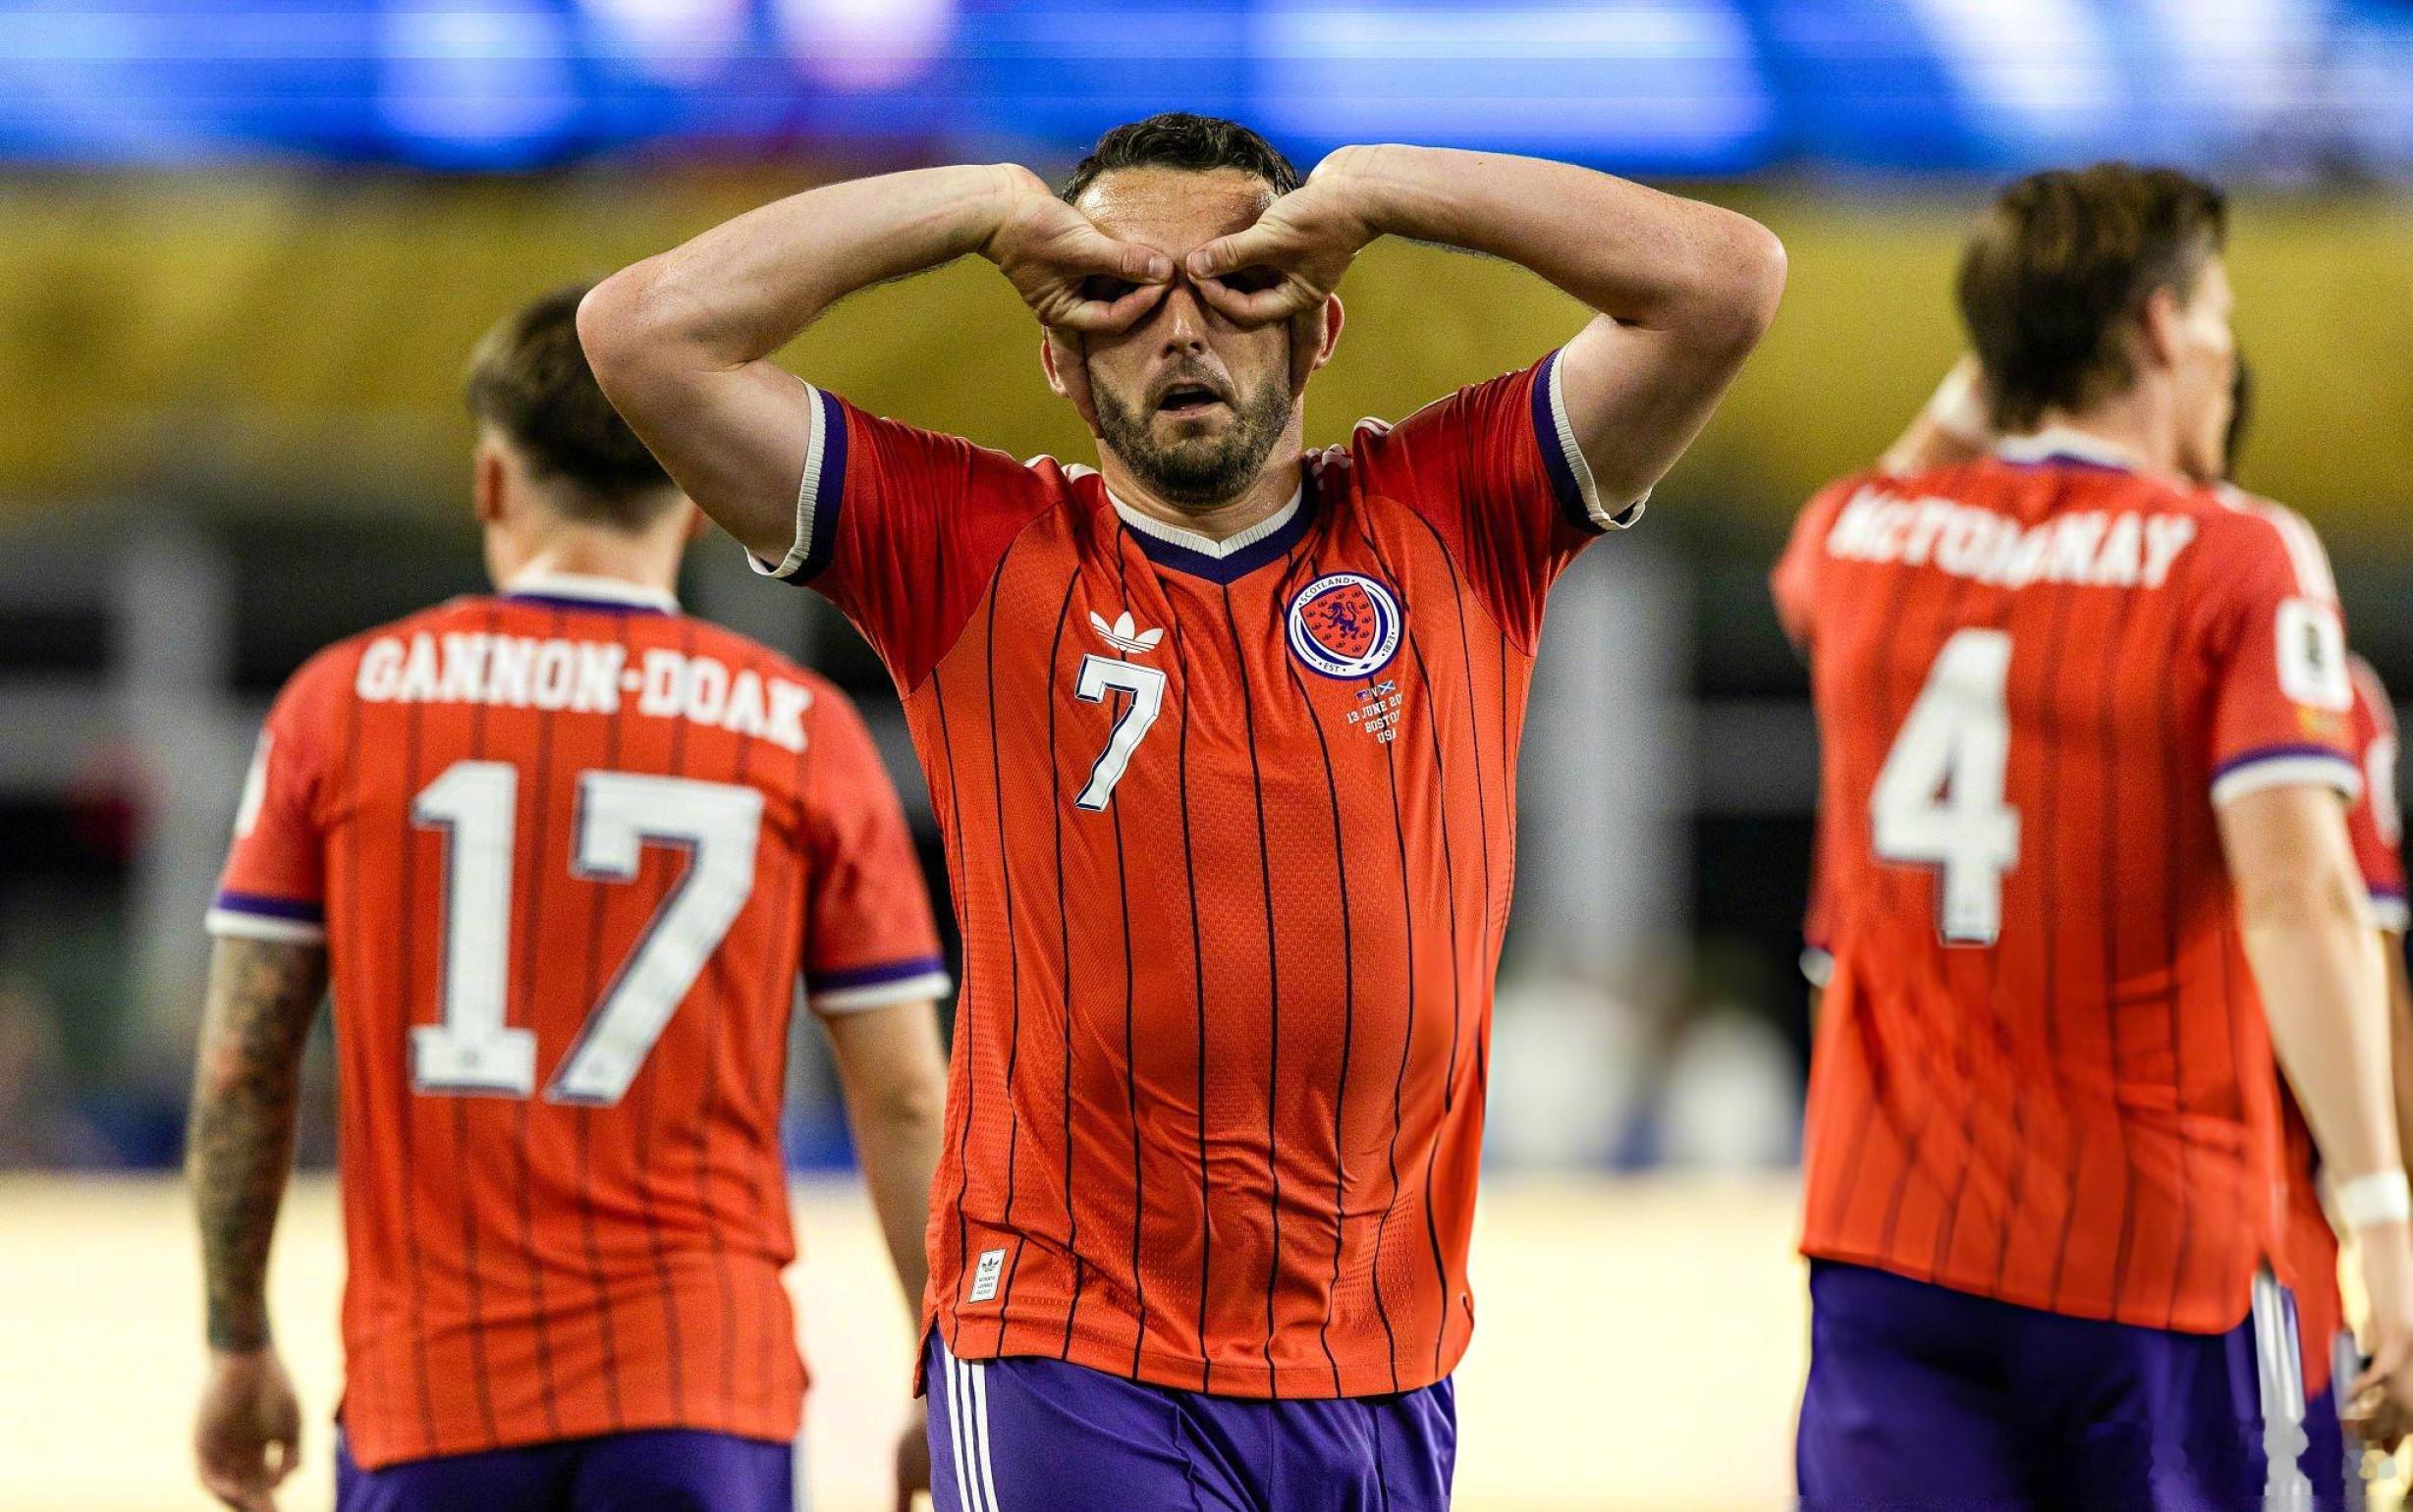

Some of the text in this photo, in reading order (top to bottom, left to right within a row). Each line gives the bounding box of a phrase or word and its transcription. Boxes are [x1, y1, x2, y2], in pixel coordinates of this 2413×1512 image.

[1300, 577, 1350, 603] SCOTLAND
[1323, 662, 1341, 673] EST
[1382, 635, 1396, 654] 1873
[355, 631, 814, 753] GANNON-DOAK
[1346, 711, 1359, 724] 13
[1361, 700, 1388, 719] JUNE
[1074, 653, 1167, 813] 7
[1871, 627, 2021, 947] 4
[411, 760, 764, 1107] 17
